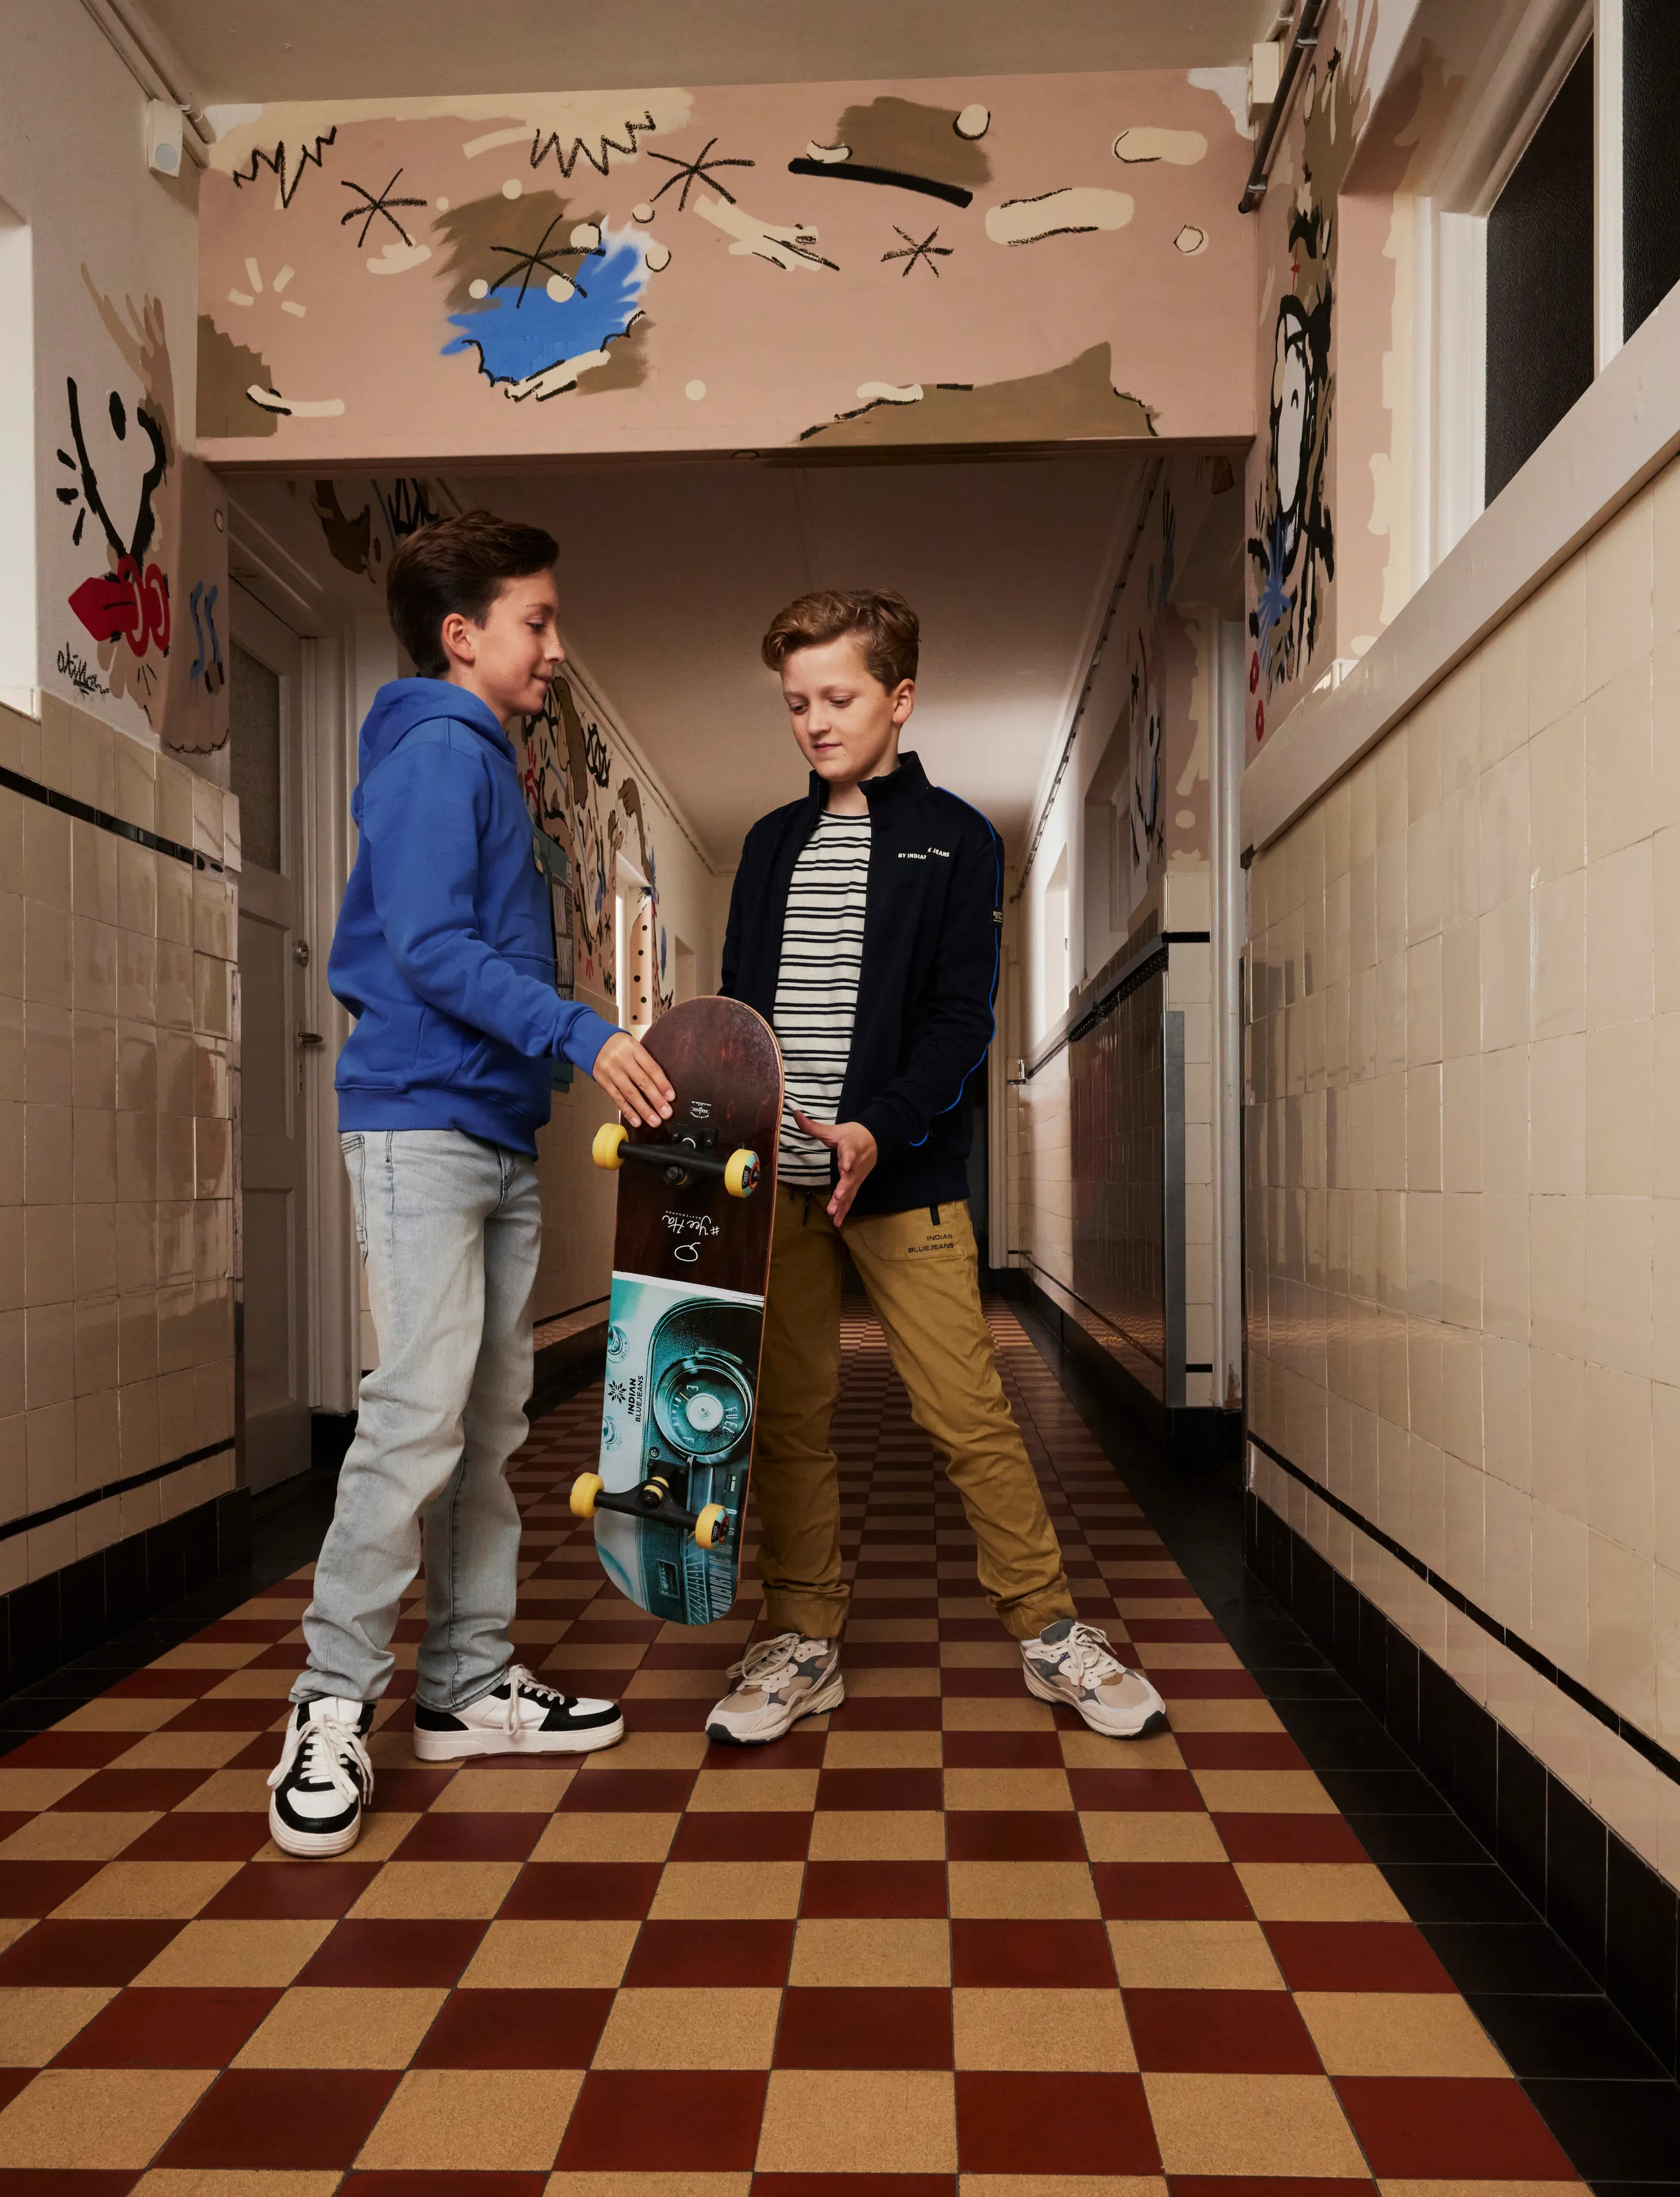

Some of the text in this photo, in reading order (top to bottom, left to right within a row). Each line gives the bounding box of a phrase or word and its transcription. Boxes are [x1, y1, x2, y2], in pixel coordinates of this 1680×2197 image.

[932, 848, 950, 857] JEANS
[665, 1210, 702, 1220] SKATEBOARDS
[908, 1243, 954, 1253] BLUEJEANS
[627, 1378, 636, 1415] INDIAN
[635, 1375, 644, 1422] BLUEJEANS
[722, 1406, 739, 1434] FUEL
